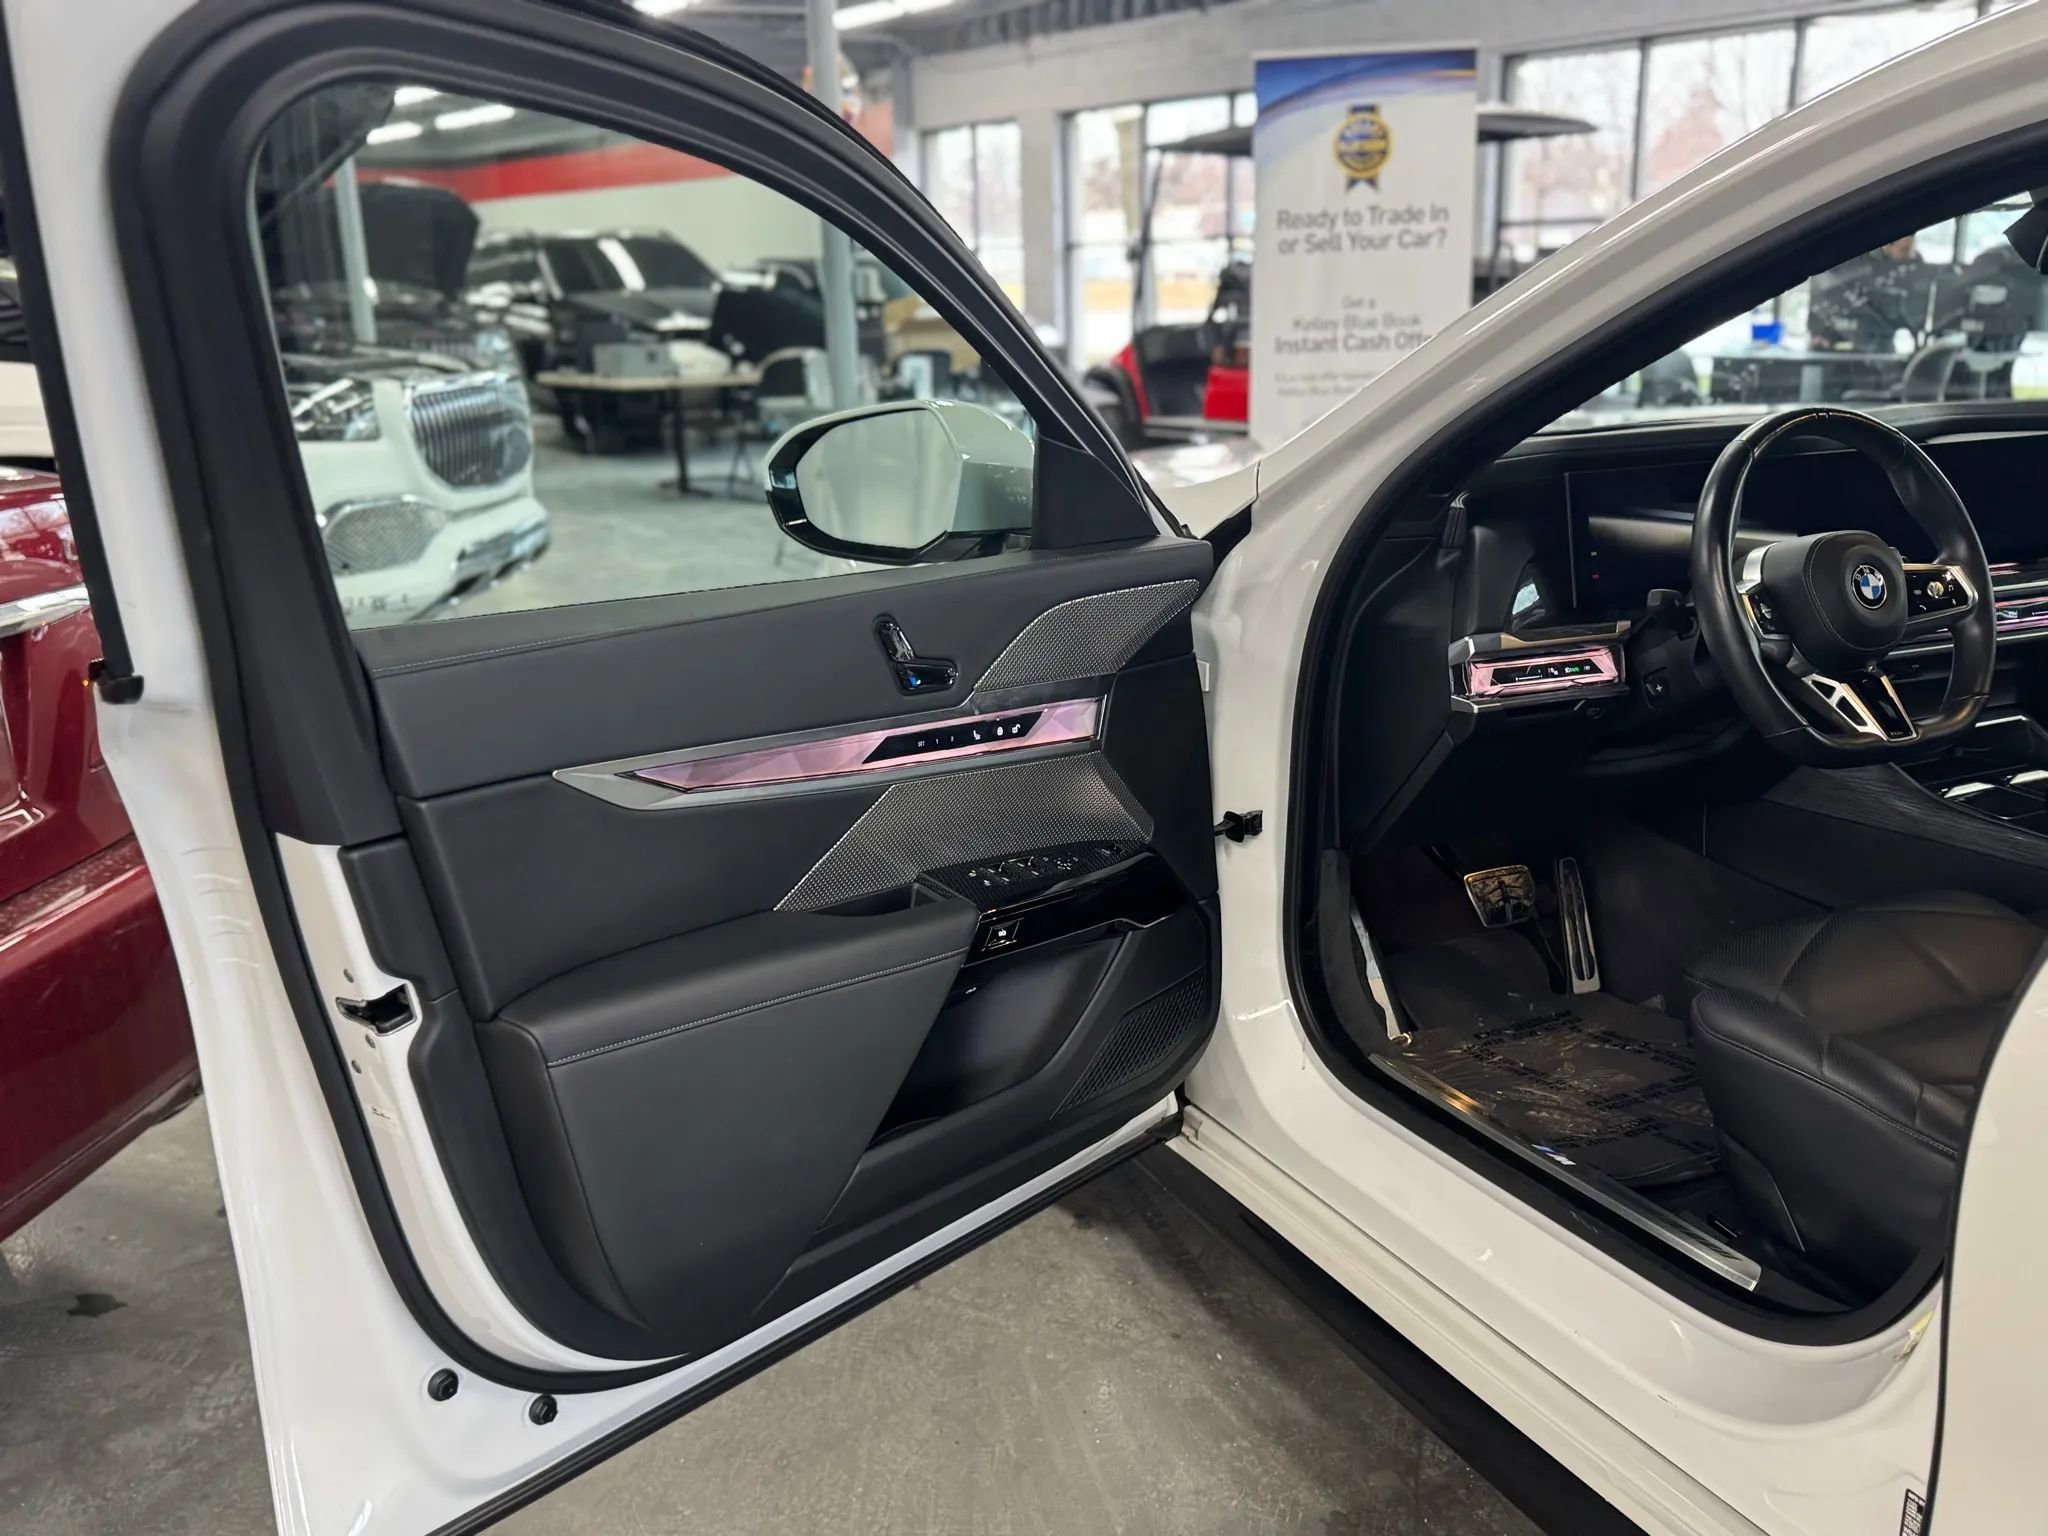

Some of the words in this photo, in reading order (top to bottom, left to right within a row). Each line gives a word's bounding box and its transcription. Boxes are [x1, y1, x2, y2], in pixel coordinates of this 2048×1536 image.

[1277, 209, 1337, 232] Ready
[1343, 206, 1363, 225] to
[1367, 204, 1425, 225] Trade
[1429, 203, 1449, 221] In
[1278, 238, 1298, 254] or
[1304, 232, 1343, 253] Sell
[1346, 231, 1393, 251] Your
[1398, 227, 1448, 249] Car?
[1343, 313, 1378, 329] Blue
[1382, 311, 1421, 328] Book
[1274, 336, 1338, 354] Instant
[1342, 333, 1391, 352] Cash
